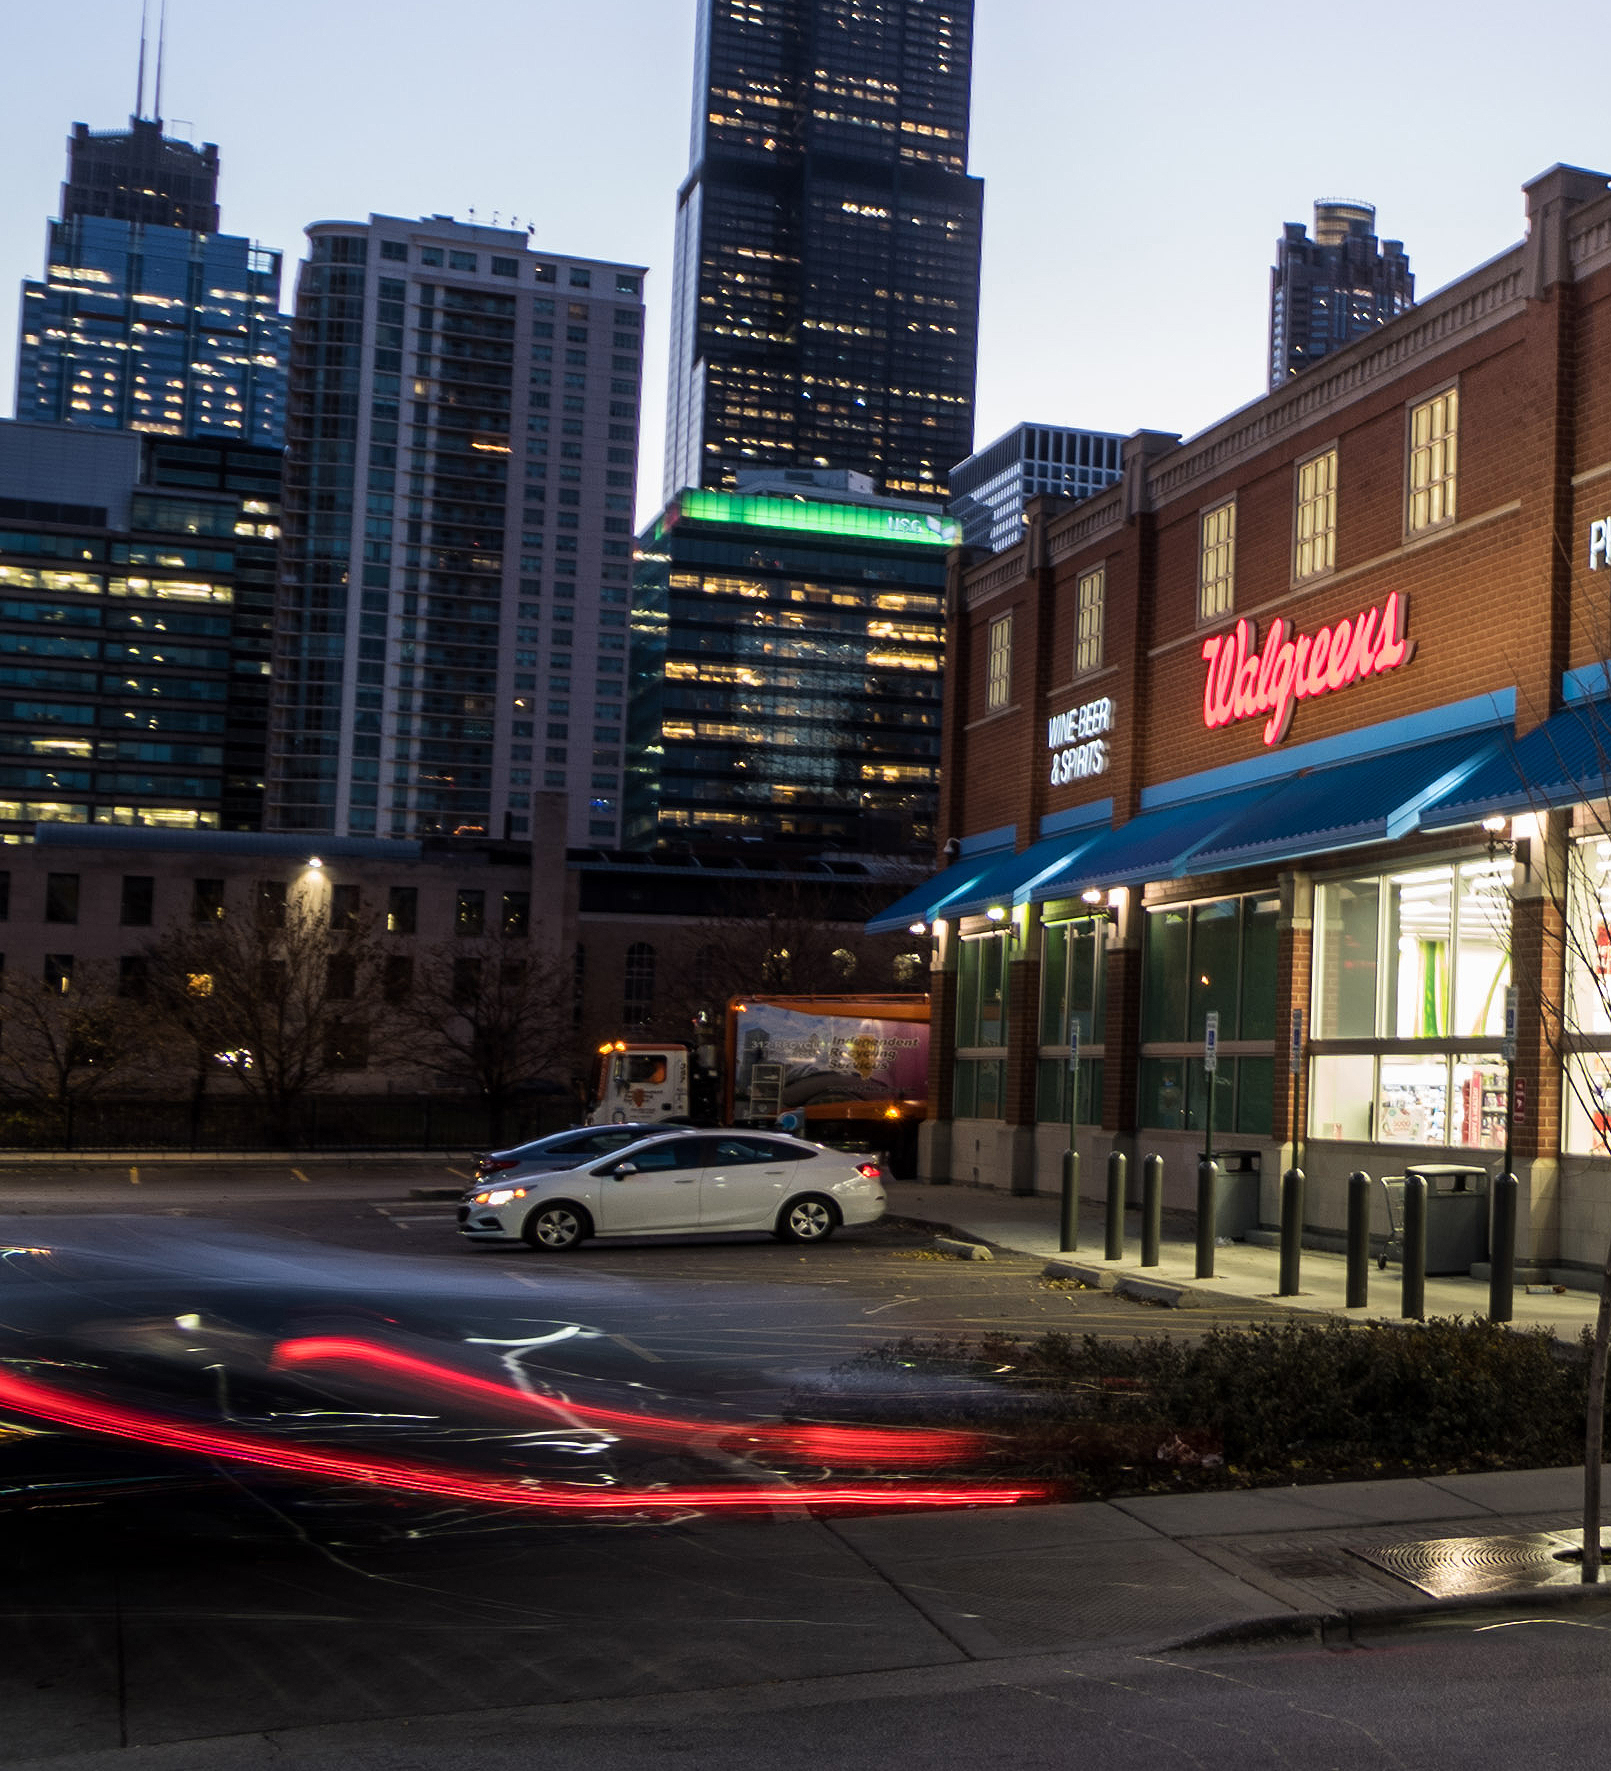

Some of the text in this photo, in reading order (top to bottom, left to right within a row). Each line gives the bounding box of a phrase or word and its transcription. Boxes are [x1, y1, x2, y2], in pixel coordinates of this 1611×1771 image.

[887, 516, 923, 534] USG
[1202, 591, 1407, 746] Walgreens
[1050, 739, 1105, 786] & SPIRITS
[832, 1036, 920, 1048] Independent
[828, 1047, 896, 1061] Recycling
[828, 1059, 888, 1071] Services
